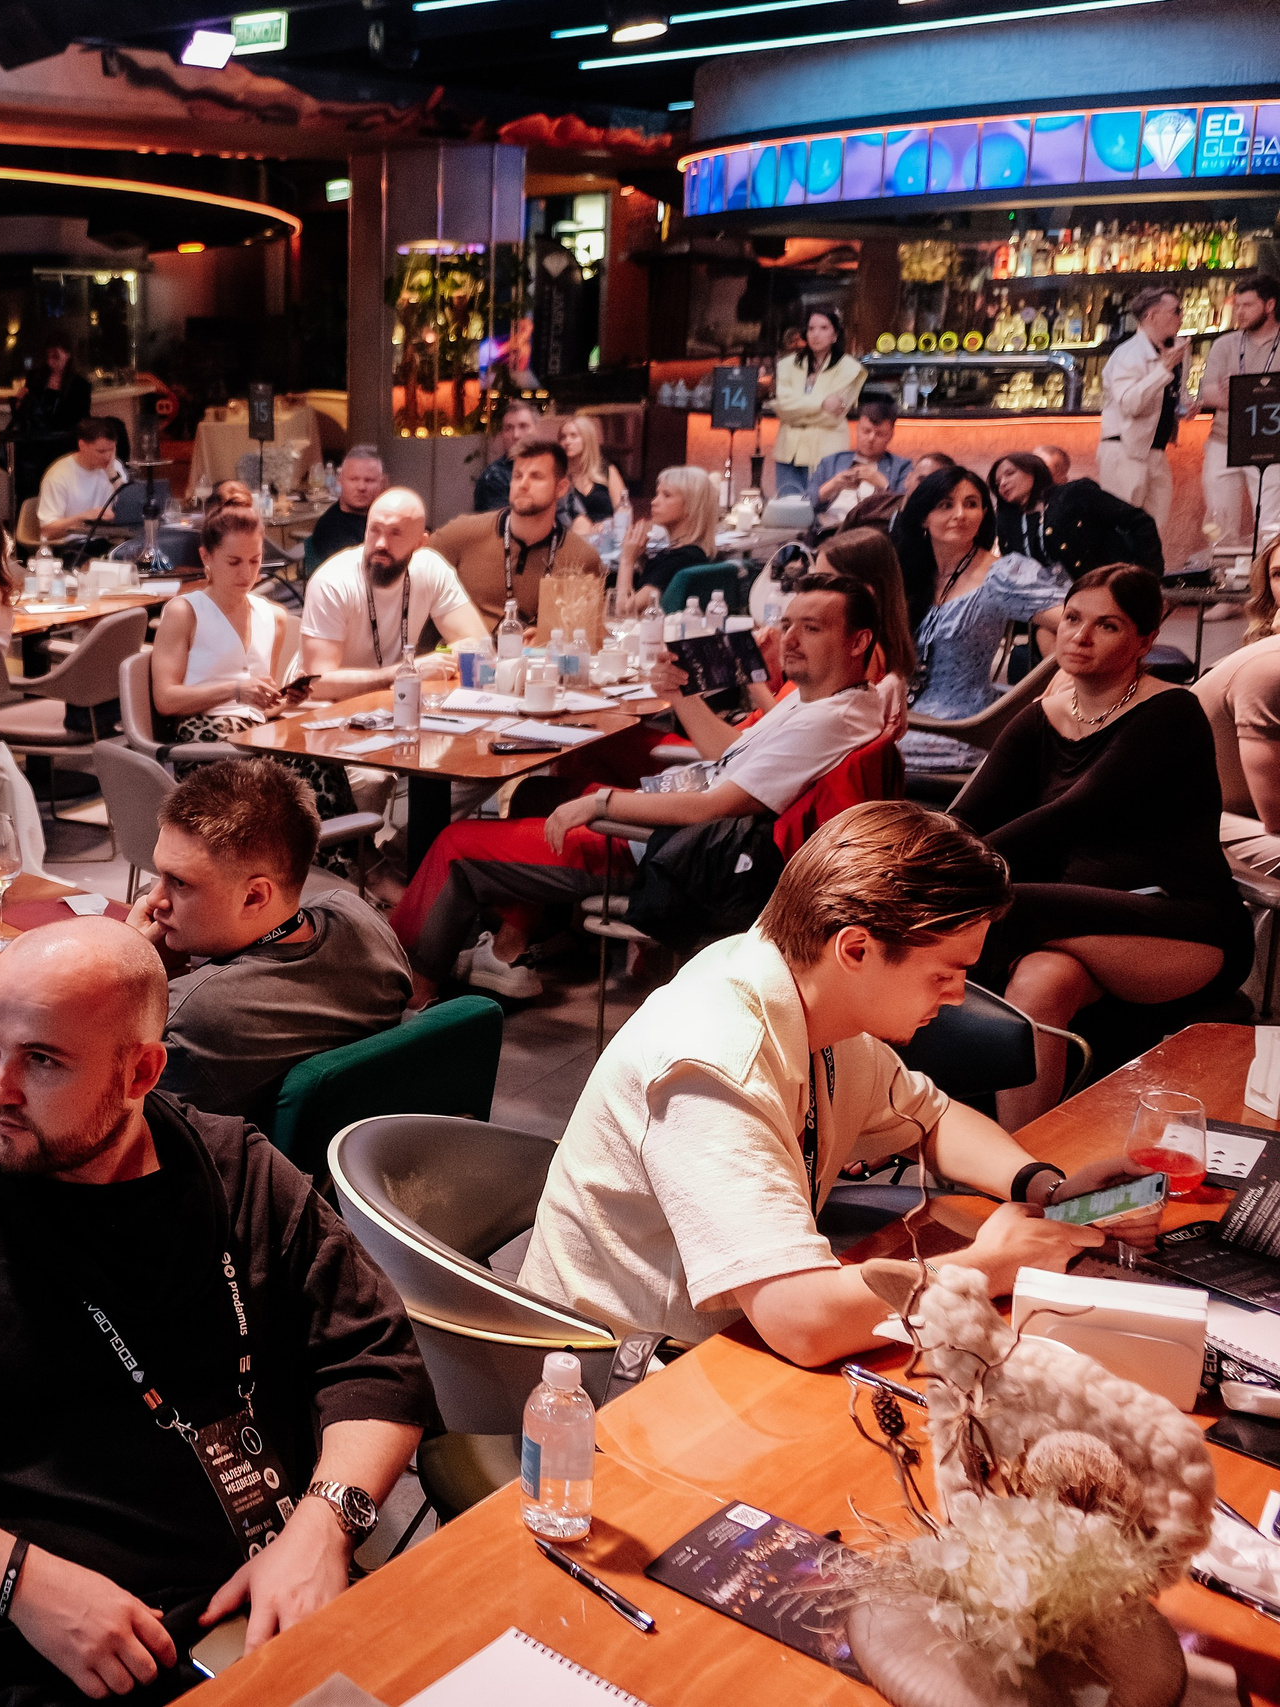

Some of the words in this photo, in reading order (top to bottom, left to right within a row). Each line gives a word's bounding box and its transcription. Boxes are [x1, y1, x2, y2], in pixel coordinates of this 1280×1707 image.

[1205, 113, 1245, 137] ED
[721, 386, 747, 411] 14
[253, 401, 269, 423] 15
[1245, 403, 1280, 436] 13
[228, 1281, 248, 1336] prodamus
[84, 1301, 138, 1371] EDGLOBA
[219, 1460, 253, 1484] ВАЛЕРИЙ
[224, 1470, 262, 1496] МЕДВЕДЕВ
